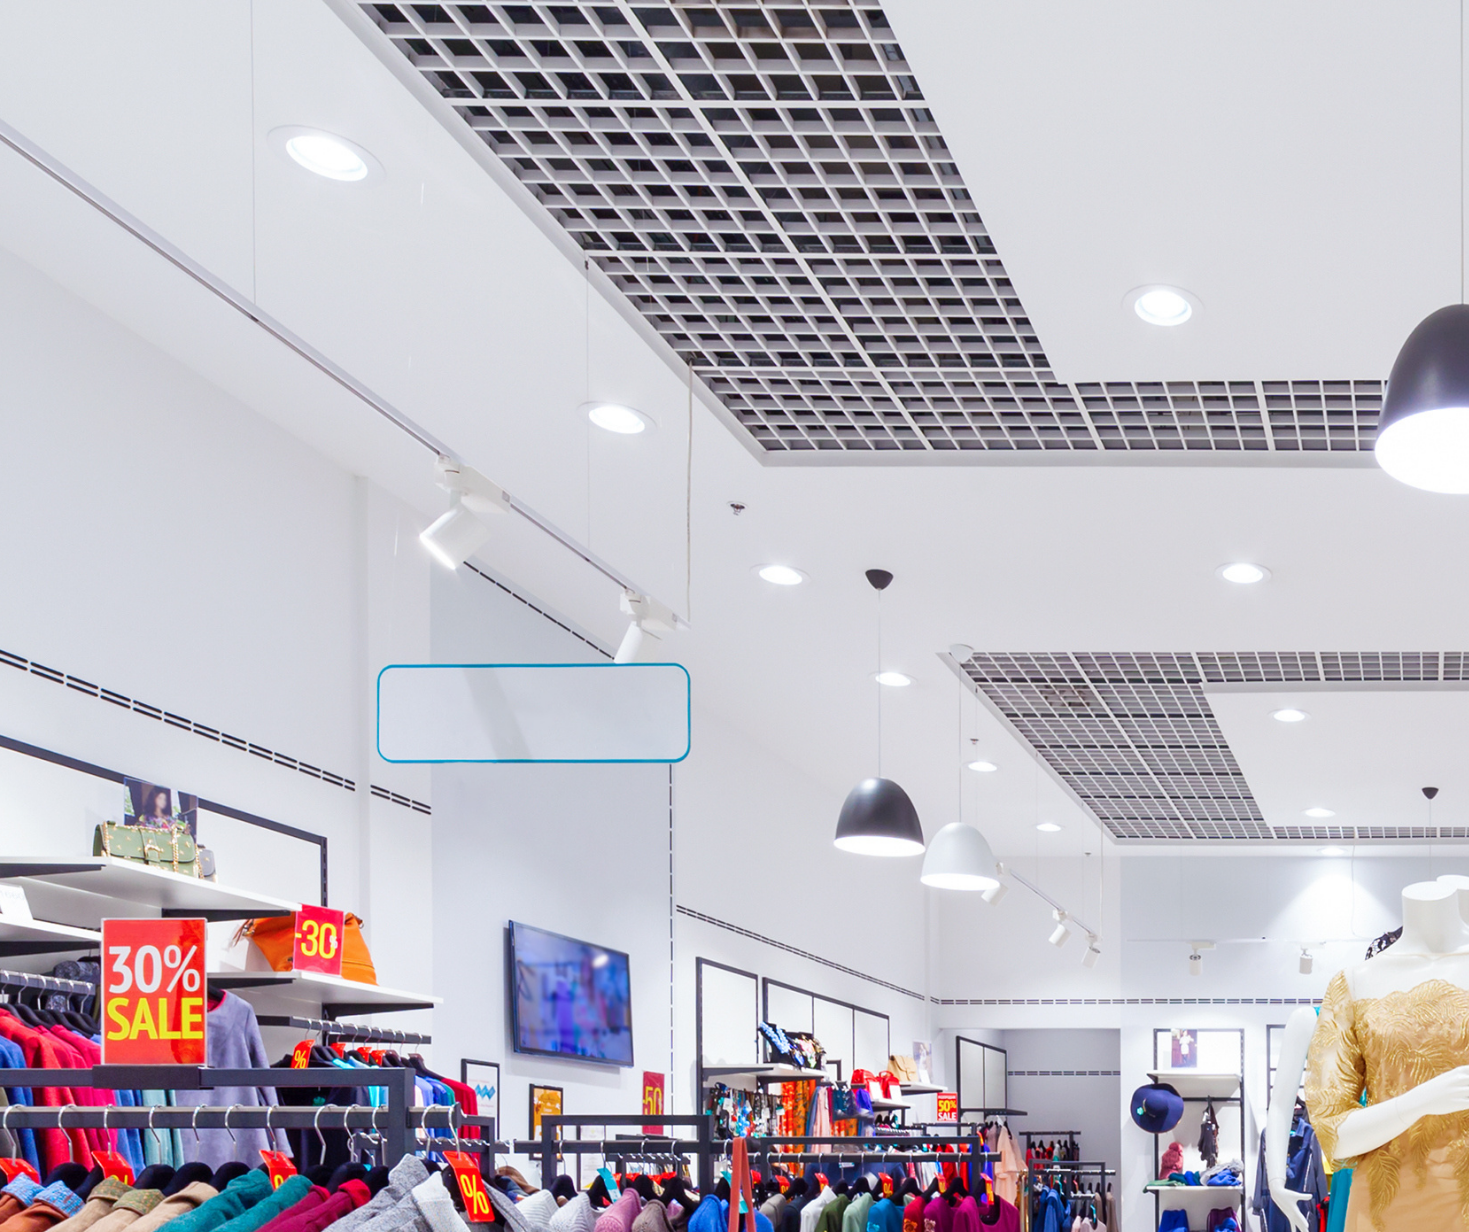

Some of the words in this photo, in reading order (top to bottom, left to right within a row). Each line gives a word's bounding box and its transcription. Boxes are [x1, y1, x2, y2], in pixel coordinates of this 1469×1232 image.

[109, 945, 200, 993] 30%
[107, 997, 203, 1041] SALE
[294, 1049, 306, 1069] %
[938, 1100, 957, 1112] 50%
[938, 1112, 957, 1121] SALE
[460, 1174, 490, 1214] %
